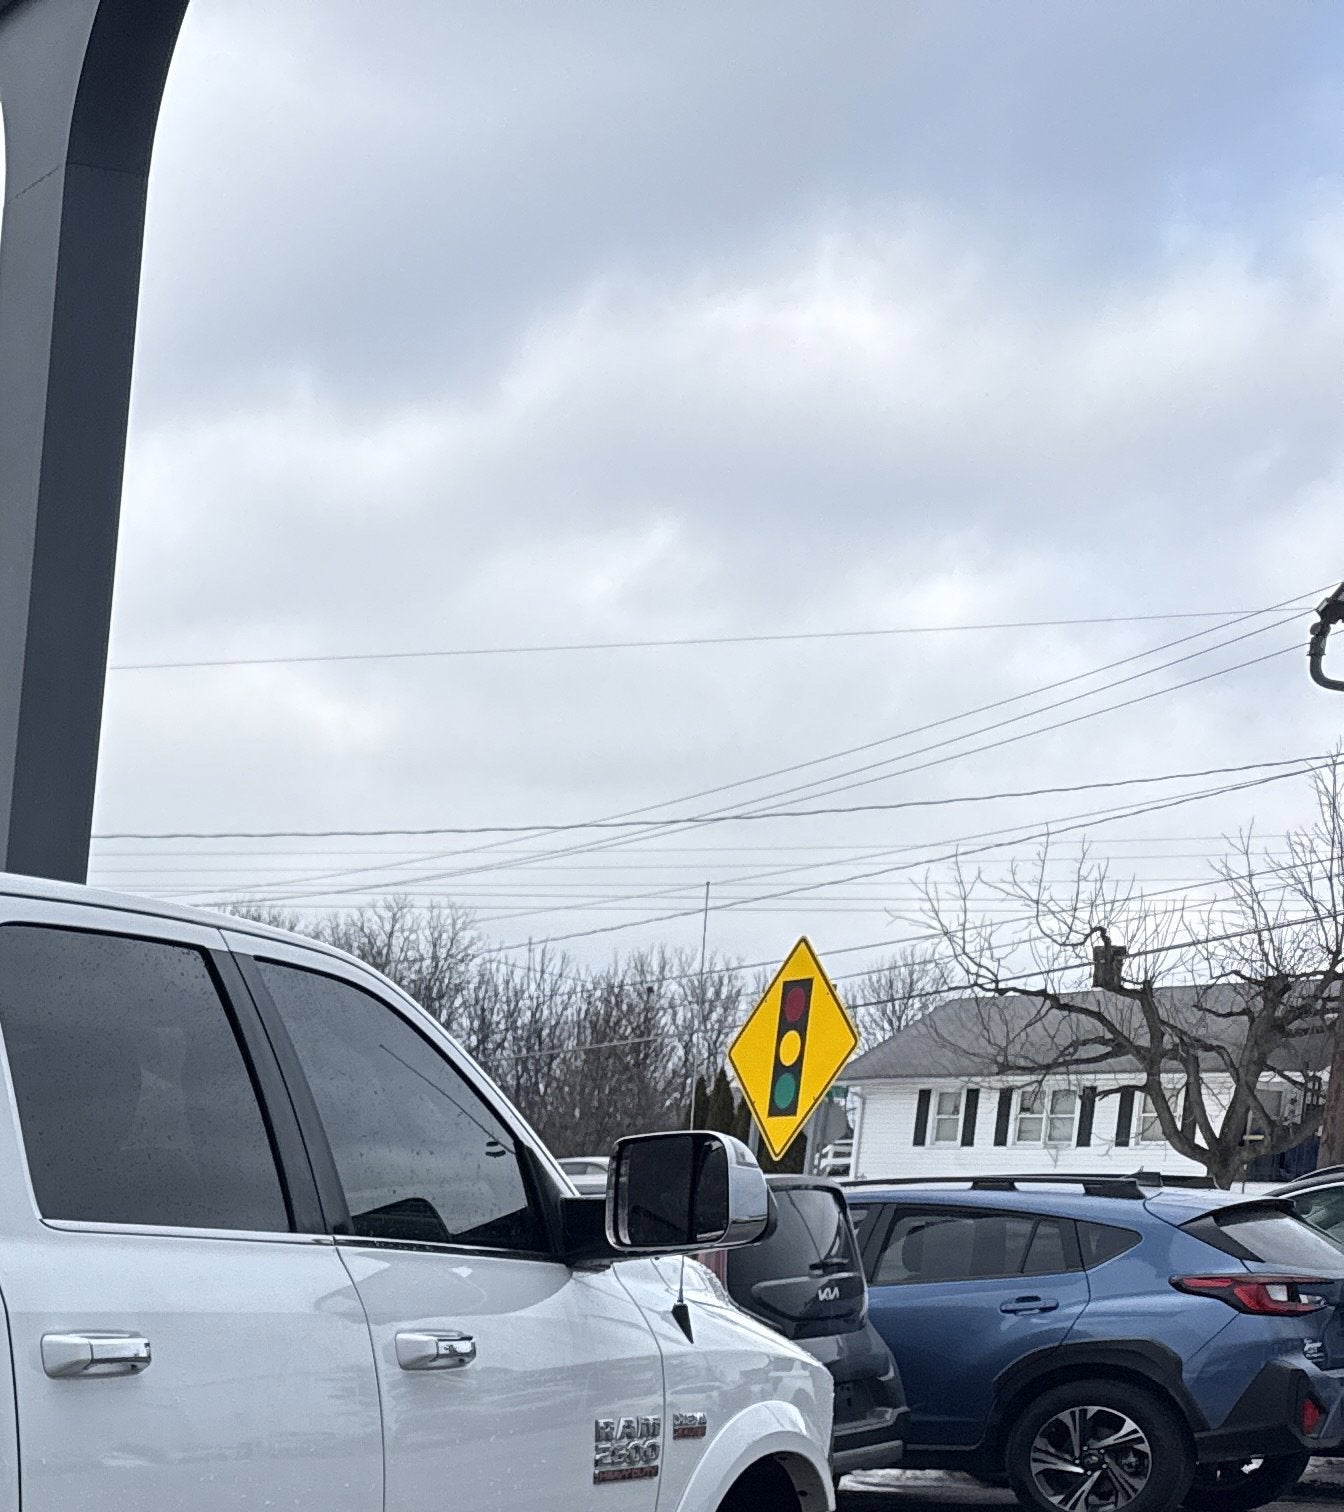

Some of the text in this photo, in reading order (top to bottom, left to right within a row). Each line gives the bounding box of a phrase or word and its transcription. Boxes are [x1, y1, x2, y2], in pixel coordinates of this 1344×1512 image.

[818, 1286, 840, 1301] KIA
[594, 1415, 662, 1442] RAM
[594, 1439, 662, 1467] 2500
